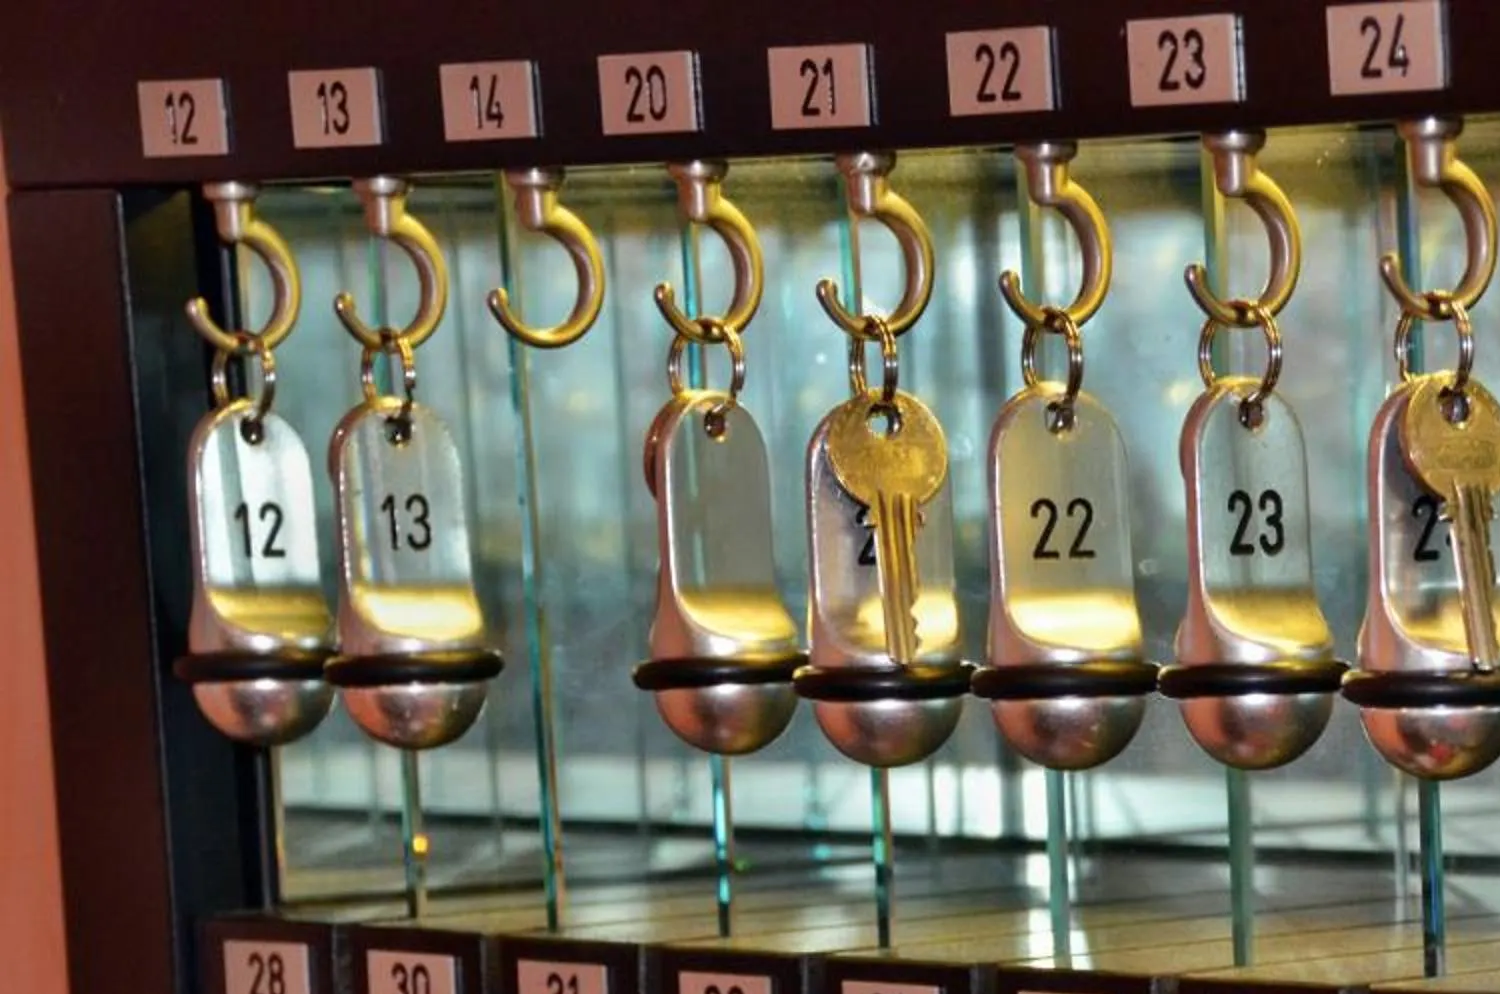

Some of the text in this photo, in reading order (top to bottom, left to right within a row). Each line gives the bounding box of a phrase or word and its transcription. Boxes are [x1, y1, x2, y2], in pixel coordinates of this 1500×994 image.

[975, 41, 1022, 103] 22
[1157, 28, 1207, 92] 23
[1359, 13, 1410, 80] 24
[316, 80, 350, 135] 13
[469, 73, 505, 130] 14
[624, 64, 668, 123] 20
[799, 57, 836, 117] 21
[164, 91, 198, 145] 12
[234, 501, 287, 558] 12
[380, 493, 432, 552] 13
[1030, 497, 1096, 560] 22
[1227, 489, 1285, 557] 23
[1411, 496, 1451, 561] 2
